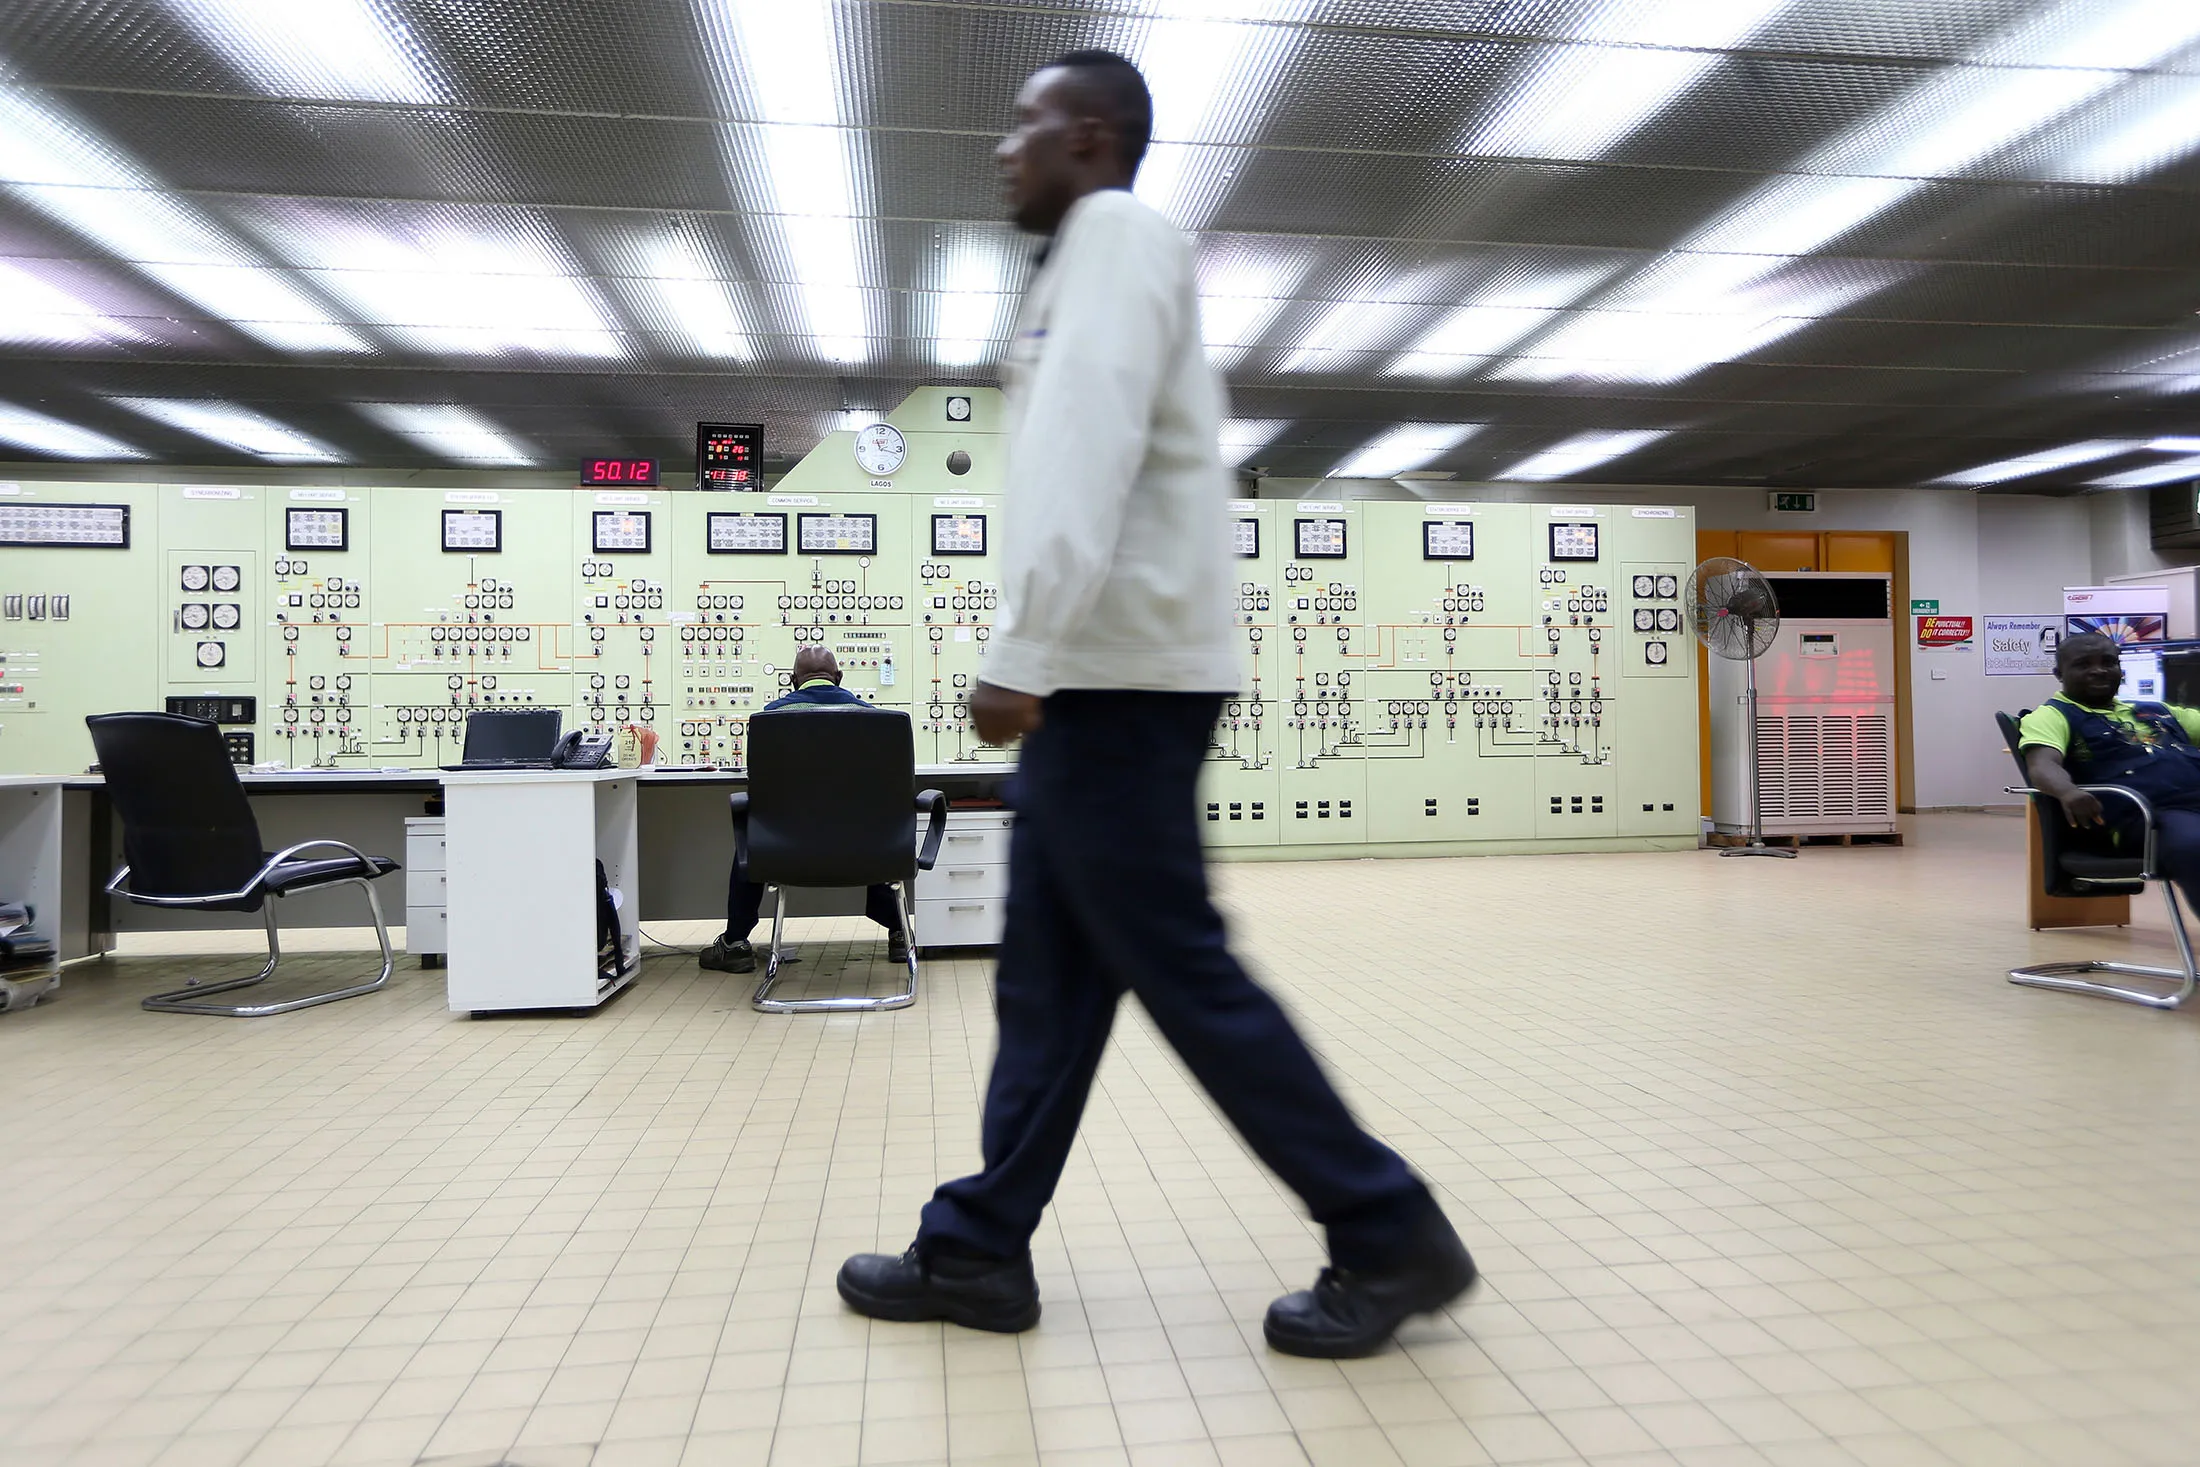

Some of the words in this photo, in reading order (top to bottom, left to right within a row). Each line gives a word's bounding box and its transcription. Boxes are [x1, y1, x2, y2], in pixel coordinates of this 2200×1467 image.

[875, 427, 886, 435] 12
[732, 445, 744, 454] 26
[858, 445, 866, 453] 9
[895, 445, 903, 453] 3
[593, 461, 651, 480] 50.12
[877, 463, 885, 471] 6
[870, 480, 892, 488] LAGOS
[1925, 617, 1937, 628] BE
[1986, 621, 2008, 632] Always
[2008, 621, 2040, 630] Remember
[1919, 628, 1933, 639] DO
[1932, 628, 1938, 636] IT
[1992, 638, 2031, 655] Safety
